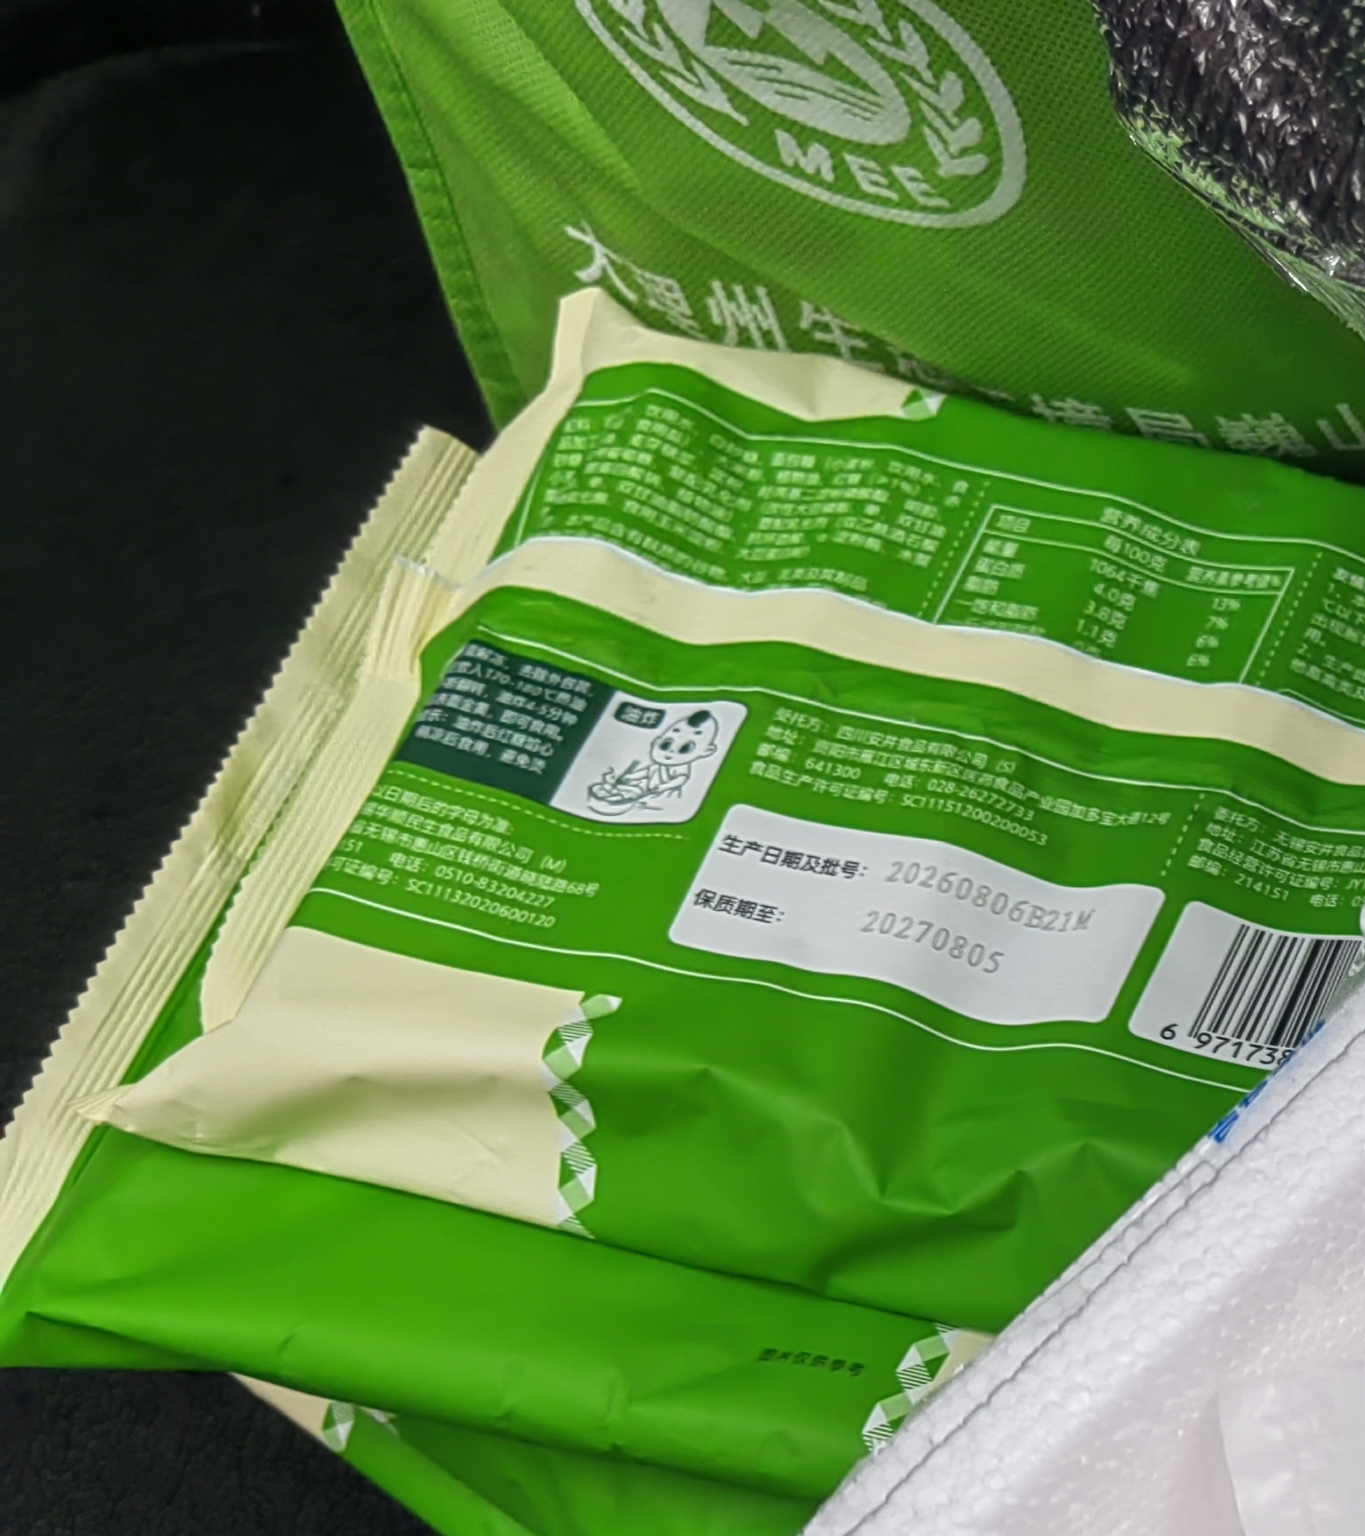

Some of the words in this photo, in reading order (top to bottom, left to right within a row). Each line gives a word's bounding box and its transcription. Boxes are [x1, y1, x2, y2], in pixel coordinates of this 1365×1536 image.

[774, 128, 950, 208] MEE
[1100, 506, 1201, 557] 营养成分表
[1103, 534, 1168, 573] 每100克
[975, 557, 1026, 579] 蛋白质
[1093, 582, 1137, 611] 4.0克
[1212, 597, 1240, 612] 13%
[1075, 620, 1118, 648] 1.1克
[621, 704, 660, 727] 油炸
[718, 834, 870, 880] 生产日期及批号：
[692, 888, 787, 926] 保质期至：
[859, 908, 1006, 977] 20270805
[1160, 1023, 1177, 1041] 6
